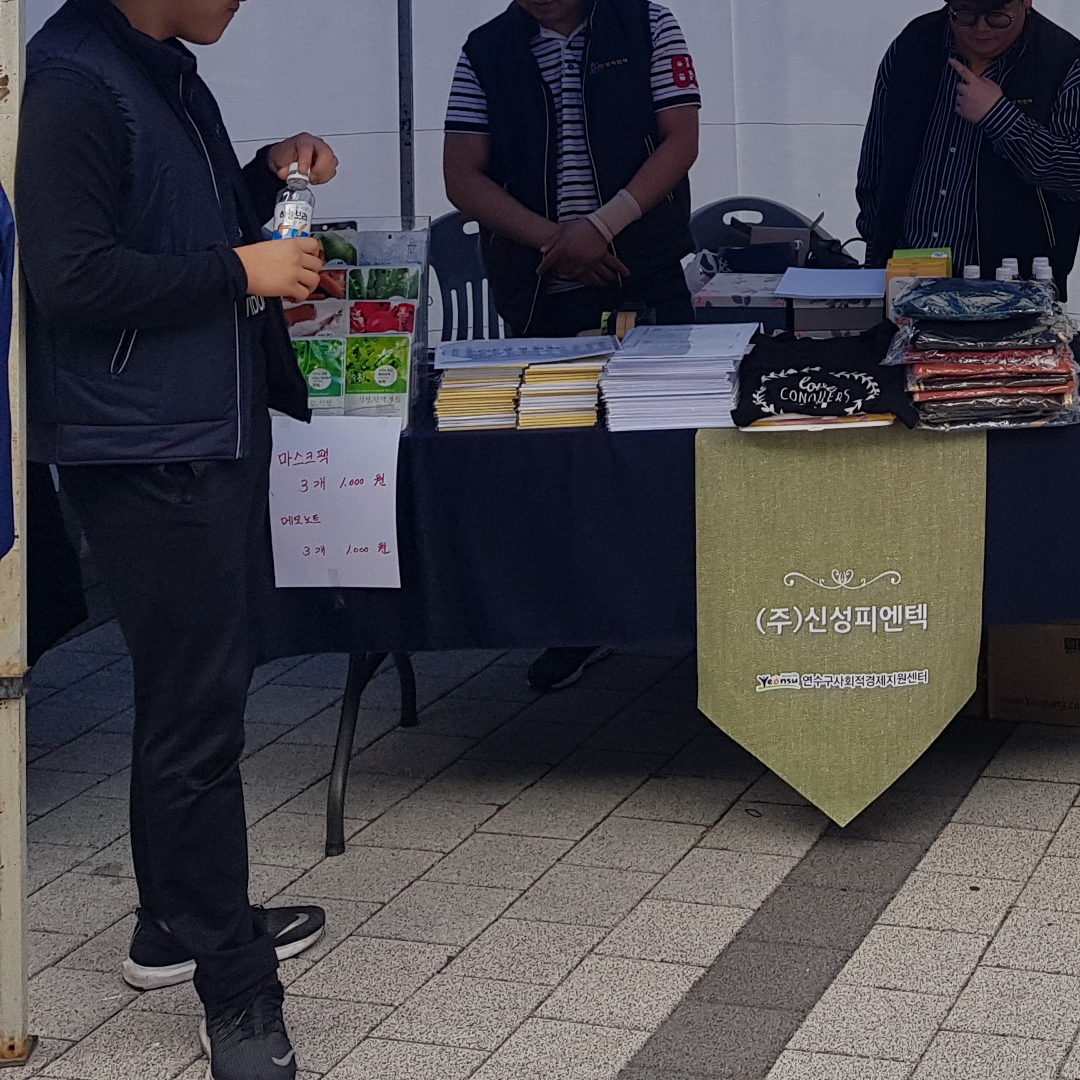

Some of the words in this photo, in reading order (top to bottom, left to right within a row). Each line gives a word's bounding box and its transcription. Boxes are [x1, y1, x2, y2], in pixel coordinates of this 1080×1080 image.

[278, 448, 329, 467] 마스크팩
[280, 514, 321, 525] 메모노트
[756, 603, 928, 634] (주)신성피엔텍
[758, 675, 798, 688] Yeonsu
[802, 671, 928, 688] 연수구사회적경제지원센터
